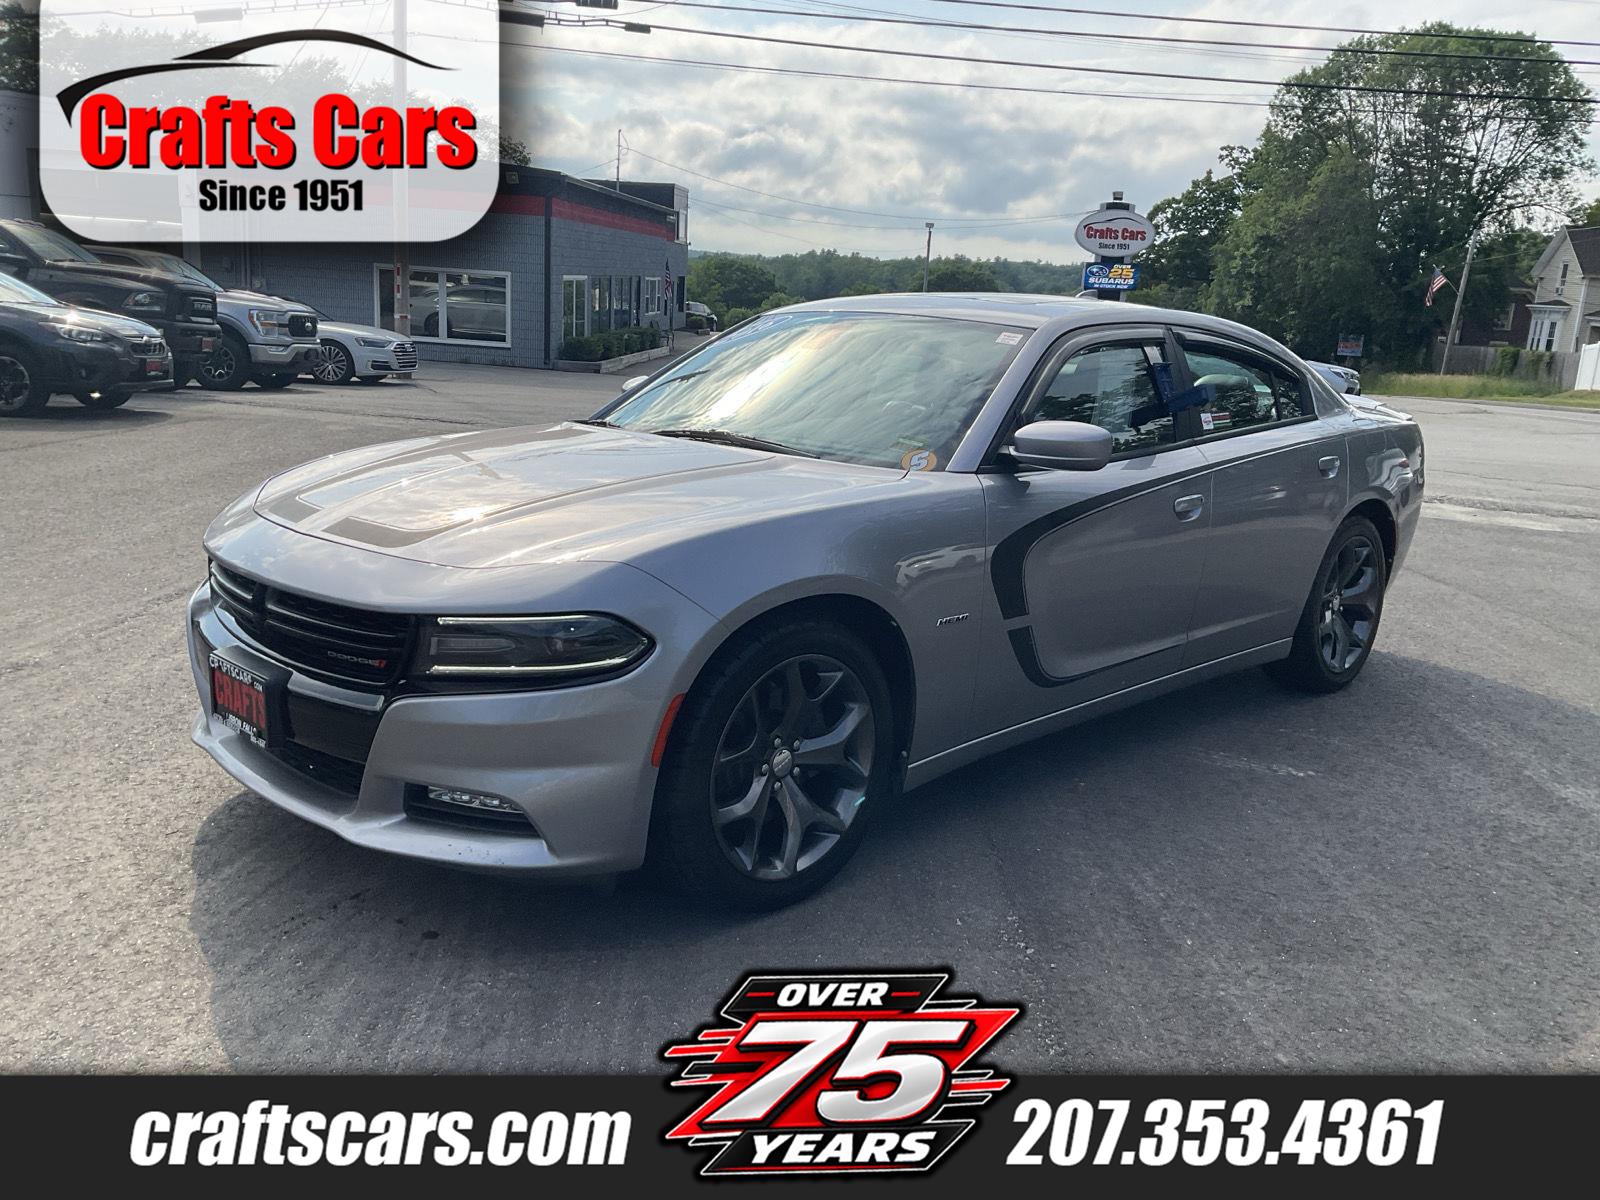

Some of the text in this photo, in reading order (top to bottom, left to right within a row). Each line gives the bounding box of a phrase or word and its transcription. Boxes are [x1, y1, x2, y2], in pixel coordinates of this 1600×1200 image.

[1086, 226, 1147, 241] Crafts Cars
[1098, 242, 1115, 250] Since
[1109, 268, 1135, 278] 25
[1088, 277, 1135, 285] SUBARUS
[936, 613, 969, 627] HEMI
[327, 650, 378, 666] DODGE
